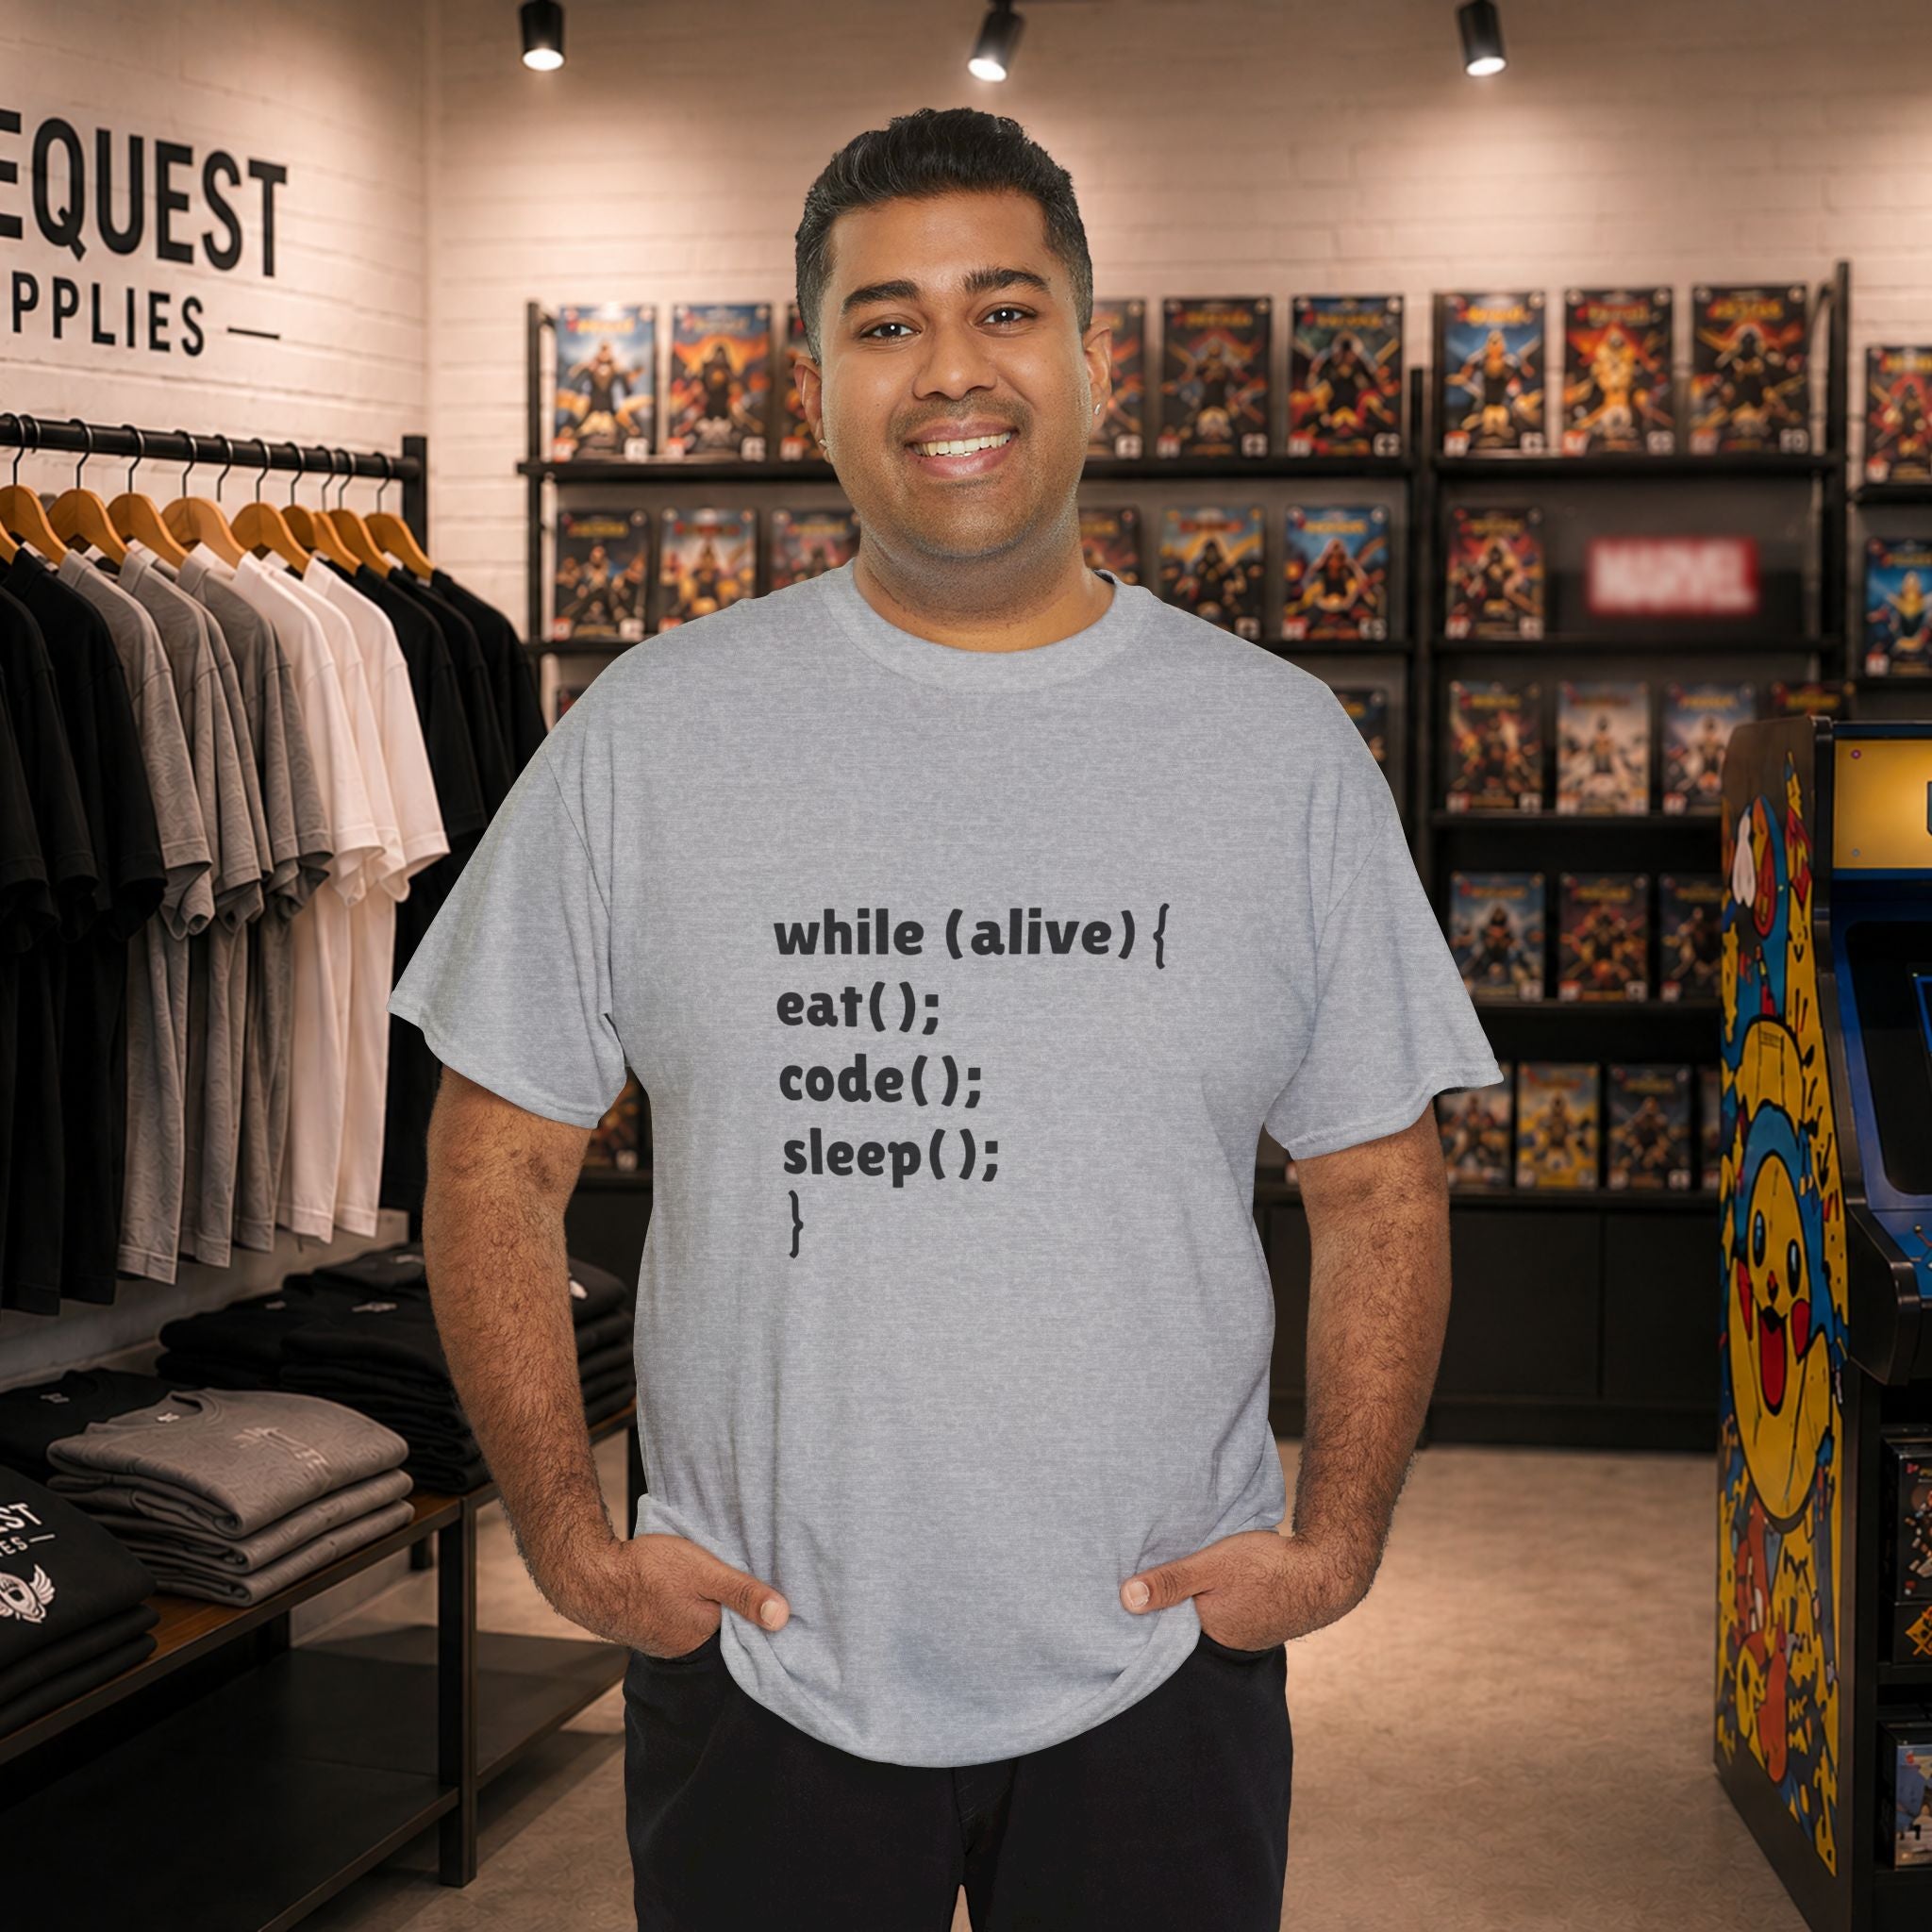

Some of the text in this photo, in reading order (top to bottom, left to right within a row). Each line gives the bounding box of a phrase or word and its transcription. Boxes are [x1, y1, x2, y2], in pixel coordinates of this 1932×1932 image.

[12, 271, 204, 357] PPLIES
[774, 903, 1170, 970] while (alive) {
[776, 981, 939, 1036] eat();
[779, 1053, 981, 1109] code();
[783, 1127, 998, 1189] sleep();
[788, 1190, 804, 1259] }
[0, 1503, 42, 1532] ST
